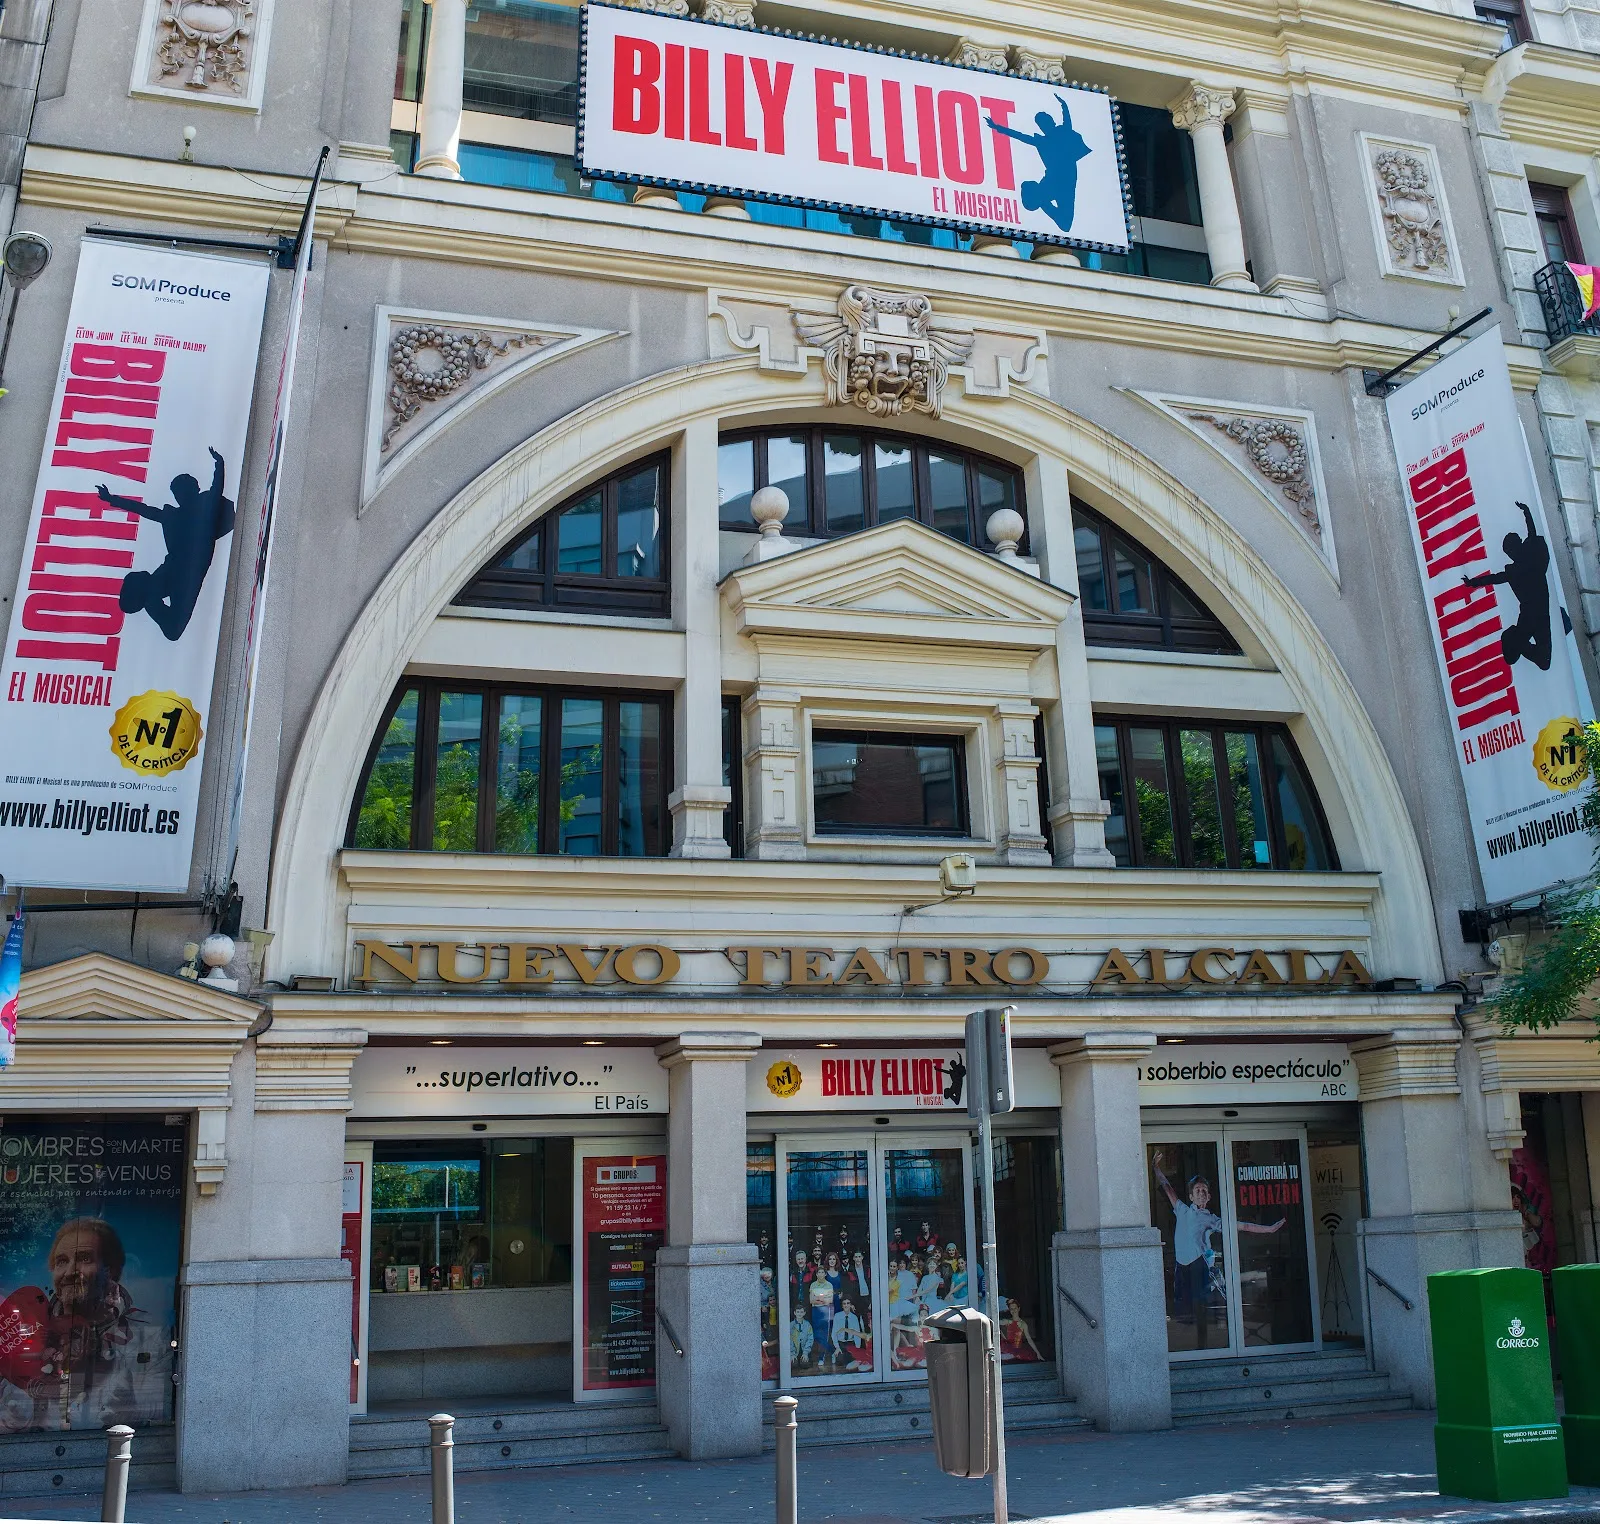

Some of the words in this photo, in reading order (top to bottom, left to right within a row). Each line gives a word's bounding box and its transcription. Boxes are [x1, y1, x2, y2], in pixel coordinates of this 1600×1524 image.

[612, 34, 794, 156] BILLY
[814, 67, 1016, 191] ELLIOT
[932, 187, 949, 215] EL
[954, 191, 1022, 225] MUSICAL
[155, 296, 185, 305] presenta
[75, 329, 95, 340] ELTON
[96, 332, 114, 341] JOHN
[120, 334, 131, 343] LEE
[132, 335, 148, 345] HALL
[153, 337, 181, 349] STEPHEN
[182, 342, 207, 353] DALDRY
[51, 342, 167, 483] BILLY
[1408, 447, 1488, 579] BILLY
[16, 490, 143, 671] ELLIOT
[1433, 569, 1521, 731] ELLIOT
[8, 671, 27, 702] EL
[32, 672, 113, 707] MUSICAL
[118, 734, 130, 750] DE
[125, 749, 139, 765] LA
[141, 747, 188, 769] CRÍTICA
[1462, 738, 1477, 766] EL
[1477, 718, 1526, 760] MUSICAL
[1540, 762, 1550, 776] DE
[1548, 774, 1558, 785] LA
[1560, 758, 1587, 786] CRÍTICA
[1486, 806, 1595, 860] www.billyelliot.e
[353, 940, 681, 986] NUEVO
[725, 946, 1051, 986] TEATRO
[1092, 947, 1374, 985] ALCALA
[821, 1059, 875, 1097] BILLY
[881, 1058, 945, 1096] ELLIOT
[1147, 1060, 1227, 1081] soberbio
[594, 1095, 610, 1110] El
[615, 1094, 649, 1110] País
[916, 1096, 922, 1106] EL
[923, 1096, 944, 1106] MUSICAL
[1321, 1083, 1347, 1097] ABC
[0, 1136, 105, 1157] OMBRES
[122, 1138, 183, 1154] MARTE
[0, 1164, 94, 1184] UJERES
[107, 1165, 171, 1182] VENUS
[613, 1170, 638, 1180] GRUPOS
[1238, 1162, 1288, 1182] CONQUISTARÁ
[1289, 1164, 1298, 1179] TU
[1315, 1168, 1343, 1184] WIFI
[10, 1188, 55, 1198] esencial
[58, 1190, 81, 1199] para
[86, 1188, 133, 1197] entender
[136, 1187, 146, 1195] la
[150, 1186, 181, 1198] pareja
[1240, 1181, 1300, 1206] CORAZÓN
[1496, 1337, 1539, 1349] CORREOS
